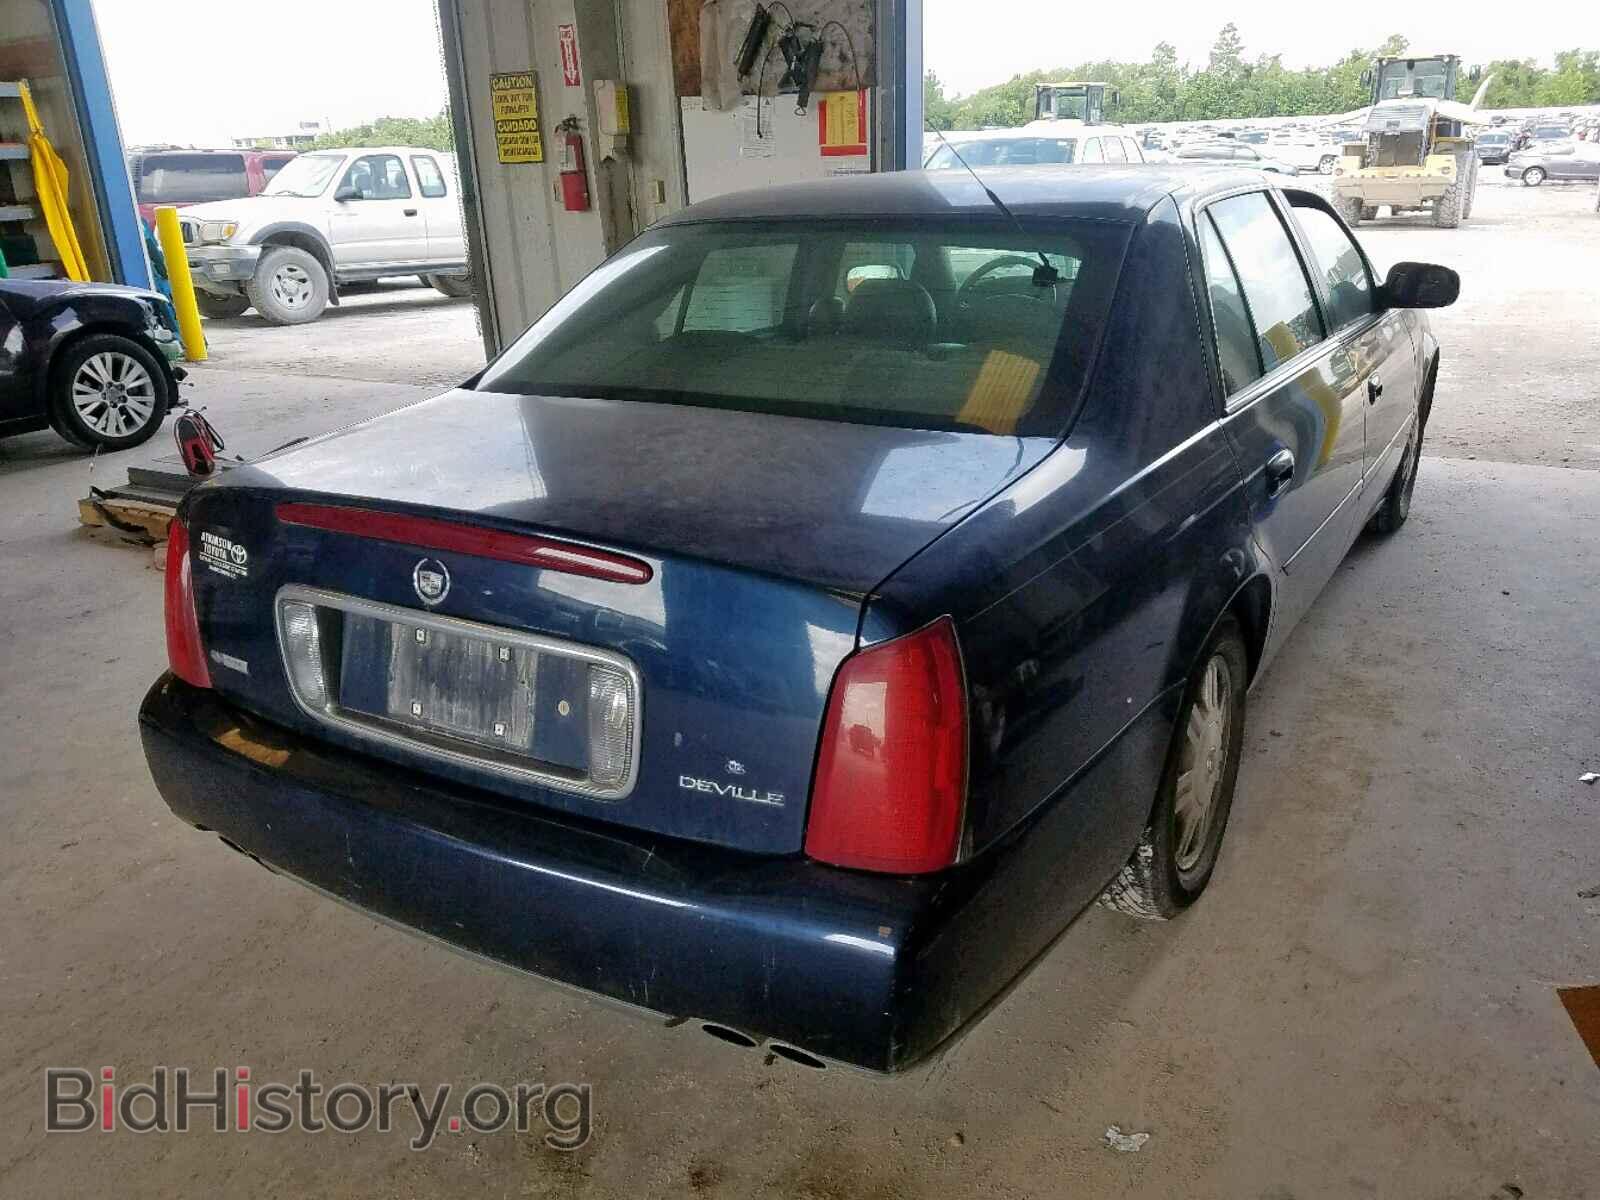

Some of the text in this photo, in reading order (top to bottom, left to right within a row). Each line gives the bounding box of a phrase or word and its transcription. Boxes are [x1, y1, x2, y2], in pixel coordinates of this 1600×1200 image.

[492, 75, 533, 89] CAUTION
[497, 119, 537, 132] CUIDADO
[203, 542, 227, 561] TOYOTA
[679, 775, 785, 807] DEVILLE
